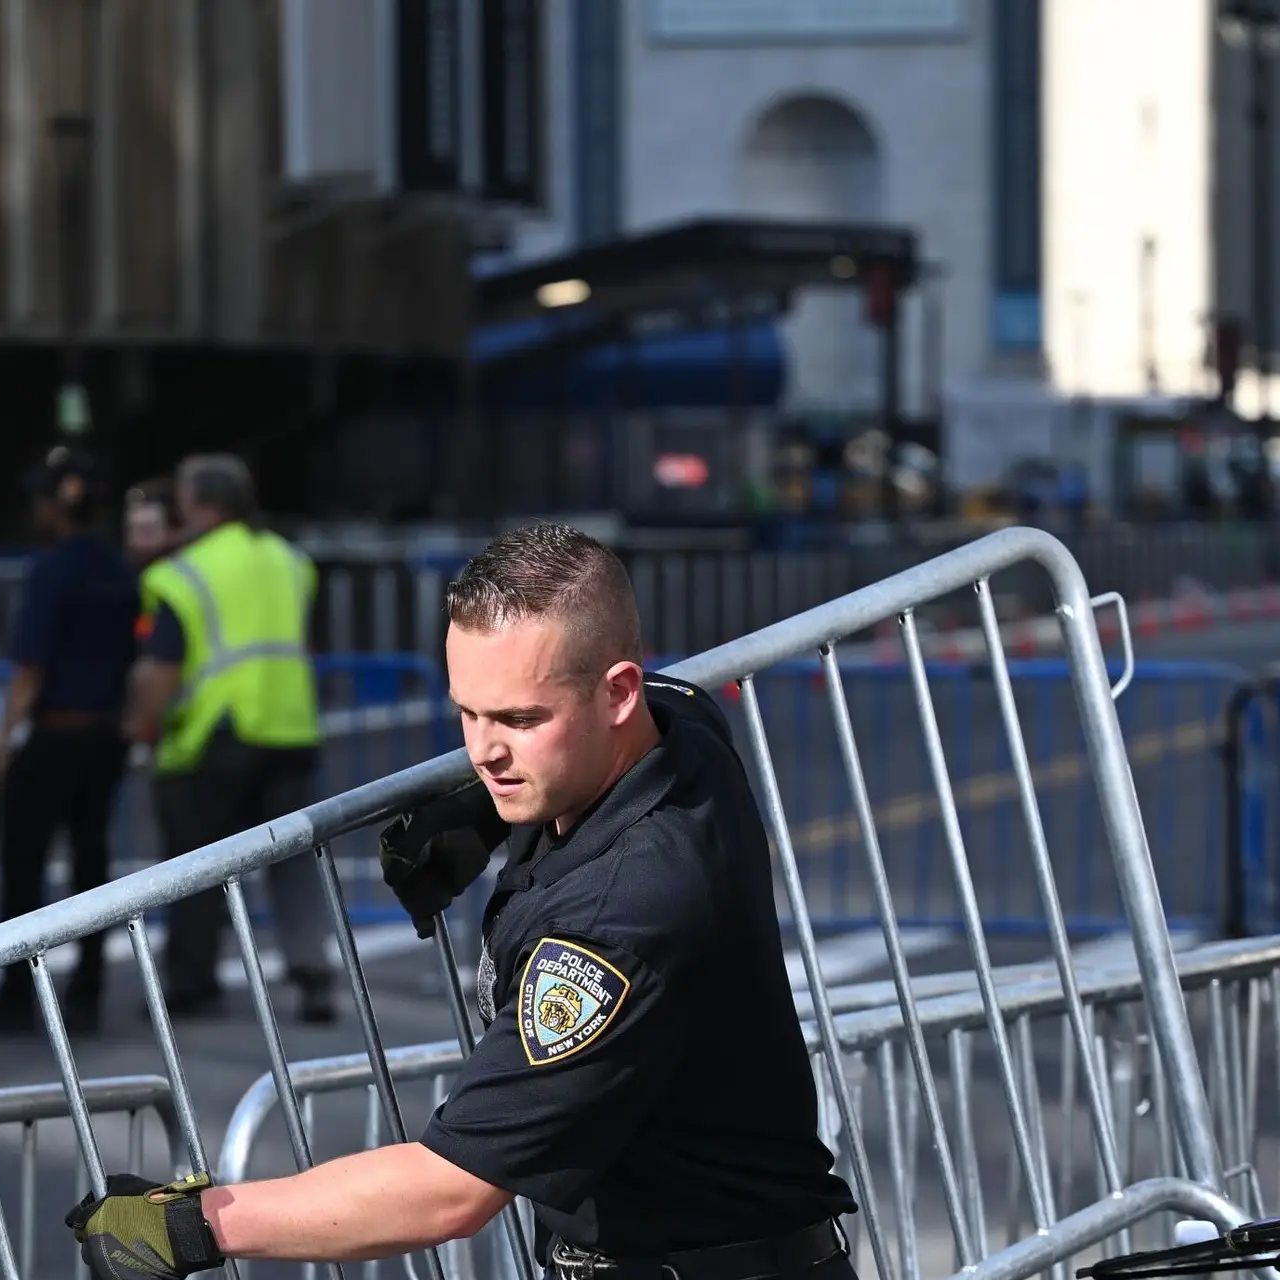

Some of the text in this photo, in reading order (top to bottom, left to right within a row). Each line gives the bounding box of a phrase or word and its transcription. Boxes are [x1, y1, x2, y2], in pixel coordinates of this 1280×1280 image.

[536, 958, 612, 1006] DEPARTMENT
[558, 951, 604, 983] POLICE
[524, 983, 535, 1038] CITY OF
[547, 1013, 607, 1056] NEW YORK
